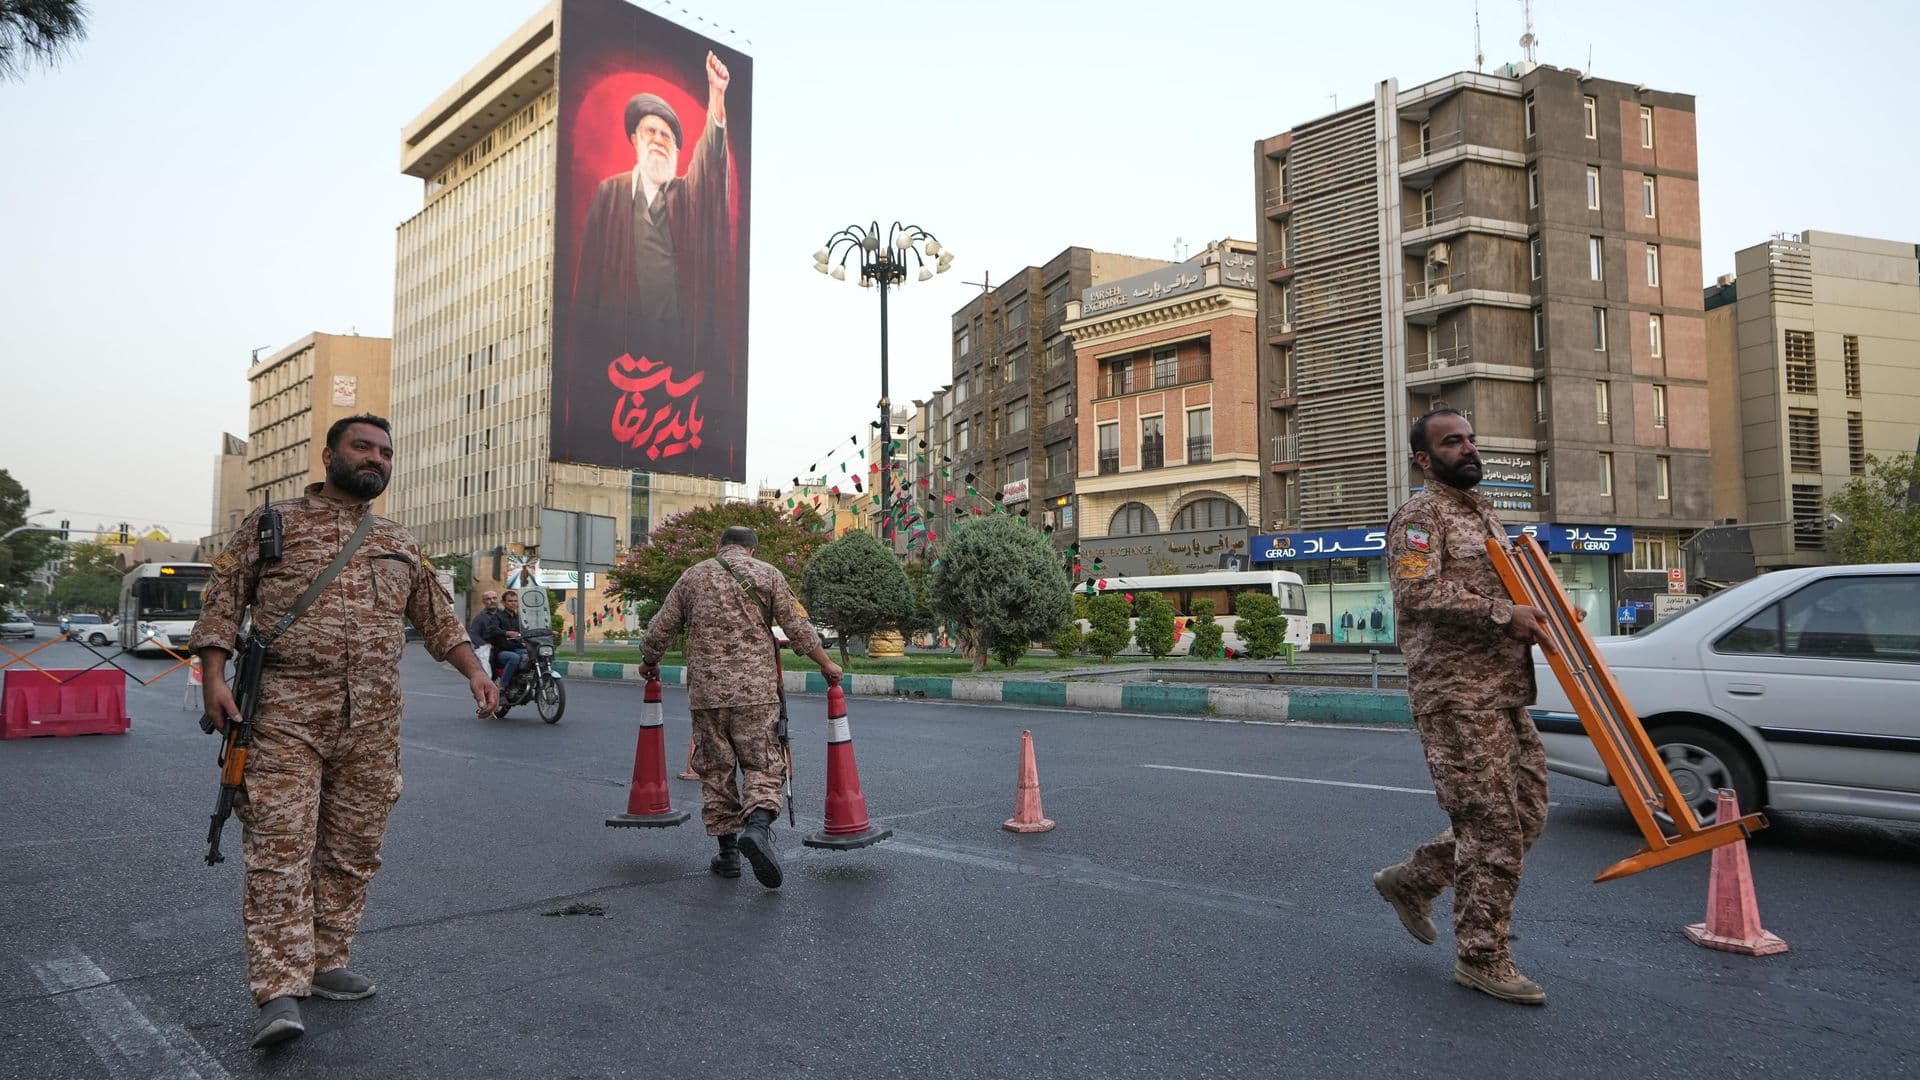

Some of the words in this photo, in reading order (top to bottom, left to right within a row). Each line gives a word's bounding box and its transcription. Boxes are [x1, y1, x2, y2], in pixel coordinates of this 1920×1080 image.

[1225, 254, 1255, 270] صرافی
[1163, 273, 1199, 293] صرافی
[1226, 271, 1256, 288] پارسه
[1090, 286, 1121, 302] PARSEH
[1133, 281, 1161, 298] پارسه
[1083, 295, 1129, 313] EXCHANGE
[1481, 456, 1511, 465] تخصصی
[1512, 457, 1531, 468] مرکز
[1502, 473, 1532, 482] ارتودنسی
[1168, 538, 1200, 557] پارسه
[1203, 534, 1244, 554] صرافی
[1584, 541, 1610, 551] GERAD
[1265, 548, 1296, 558] GERAD
